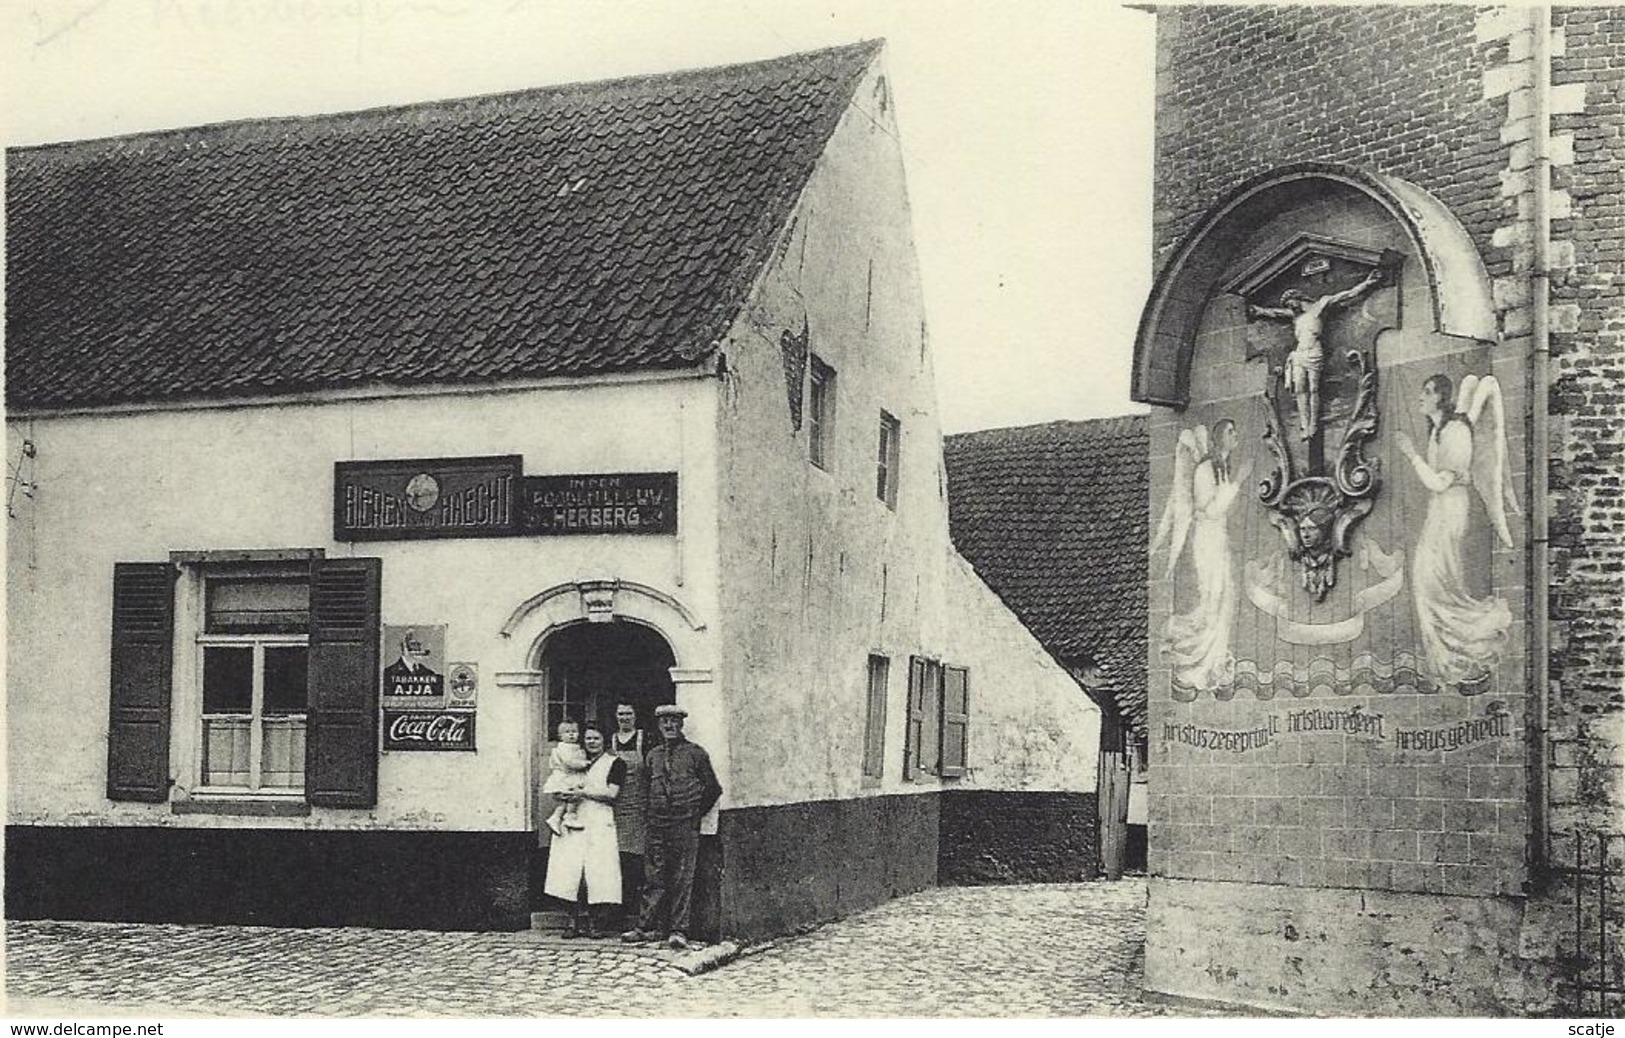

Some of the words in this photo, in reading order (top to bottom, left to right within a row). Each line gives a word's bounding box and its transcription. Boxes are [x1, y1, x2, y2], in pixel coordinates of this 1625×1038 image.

[345, 486, 407, 528] BIEREN
[441, 473, 513, 526] HAECHT
[553, 507, 640, 527] HERBERG
[391, 676, 437, 684] TABAKKEN
[394, 684, 433, 695] AJJA
